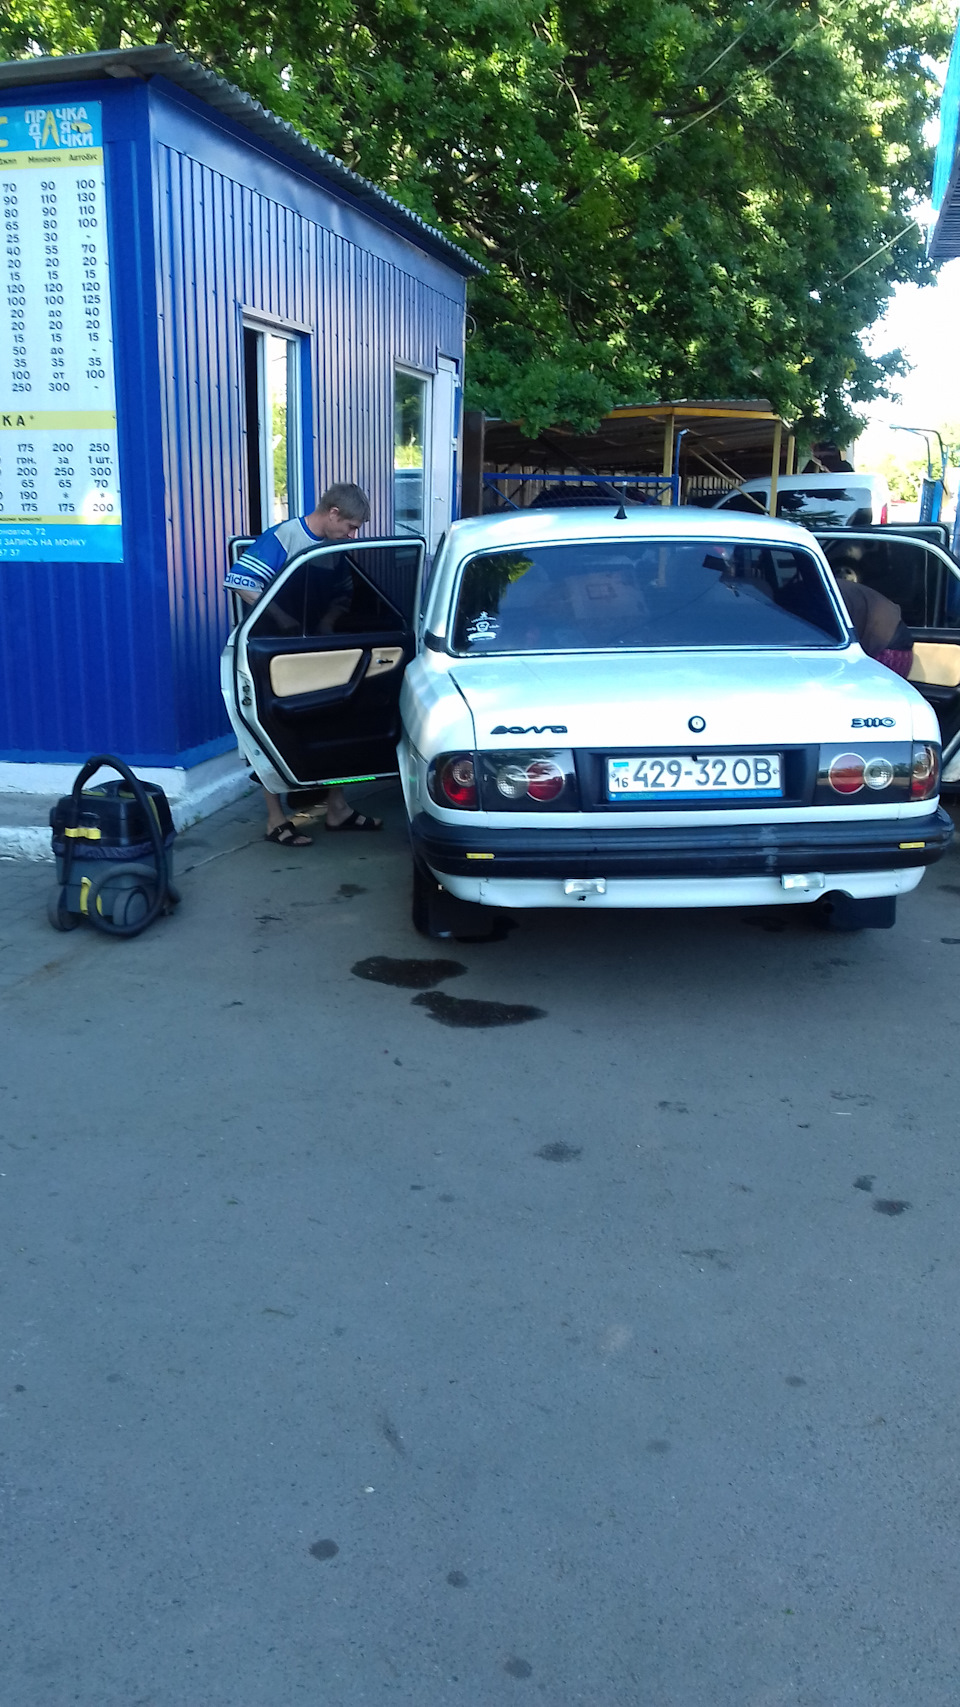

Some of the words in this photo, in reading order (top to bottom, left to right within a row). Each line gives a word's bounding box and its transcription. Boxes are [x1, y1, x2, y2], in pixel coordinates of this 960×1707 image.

[2, 183, 17, 193] 70
[41, 181, 55, 191] 90
[76, 179, 95, 189] 100
[3, 196, 18, 205] 90
[41, 194, 57, 204] 110
[77, 192, 95, 202] 130
[4, 209, 18, 218] 80
[42, 207, 57, 216] 90
[79, 205, 95, 215] 110
[5, 221, 19, 230] 65
[43, 220, 57, 229] 80
[78, 218, 97, 228] 100
[6, 234, 19, 243] 25
[44, 232, 58, 242] 30
[7, 246, 21, 256] 40
[45, 245, 58, 255] 55
[81, 244, 96, 253] 70
[8, 259, 21, 268] 20
[45, 258, 59, 267] 20
[83, 257, 97, 266] 20
[10, 272, 20, 281] 15
[48, 271, 58, 280] 15
[85, 269, 96, 279] 15
[7, 284, 25, 293] 120
[44, 283, 63, 292] 120
[82, 282, 100, 291] 120
[7, 297, 26, 306] 100
[44, 296, 64, 305] 100
[82, 295, 100, 304] 125
[10, 309, 24, 318] 20
[85, 307, 99, 317] 40
[11, 322, 25, 331] 20
[49, 321, 63, 330] 20
[86, 320, 100, 329] 20
[14, 334, 24, 343] 15
[51, 333, 62, 342] 15
[88, 332, 99, 341] 15
[13, 346, 26, 355] 50
[14, 359, 27, 368] 35
[51, 358, 64, 367] 35
[88, 357, 101, 366] 35
[12, 371, 30, 380] 100
[86, 370, 104, 378] 100
[12, 383, 32, 392] 250
[49, 382, 70, 391] 300
[17, 444, 34, 452] 175
[53, 443, 73, 452] 200
[89, 443, 110, 452] 250
[88, 456, 92, 464] 1
[17, 468, 37, 476] 200
[54, 467, 74, 476] 250
[90, 467, 111, 476] 300
[21, 479, 34, 488] 65
[58, 479, 72, 488] 65
[94, 479, 108, 488] 70
[19, 491, 37, 500] 190
[21, 503, 38, 511] 175
[58, 503, 75, 512] 175
[93, 504, 113, 512] 200
[4, 538, 38, 546] ЗАПИСЬ
[40, 538, 53, 546] НА
[55, 537, 86, 546] МОЙКУ
[225, 574, 256, 587] didas
[851, 716, 896, 728] 3110
[614, 777, 629, 789] 16
